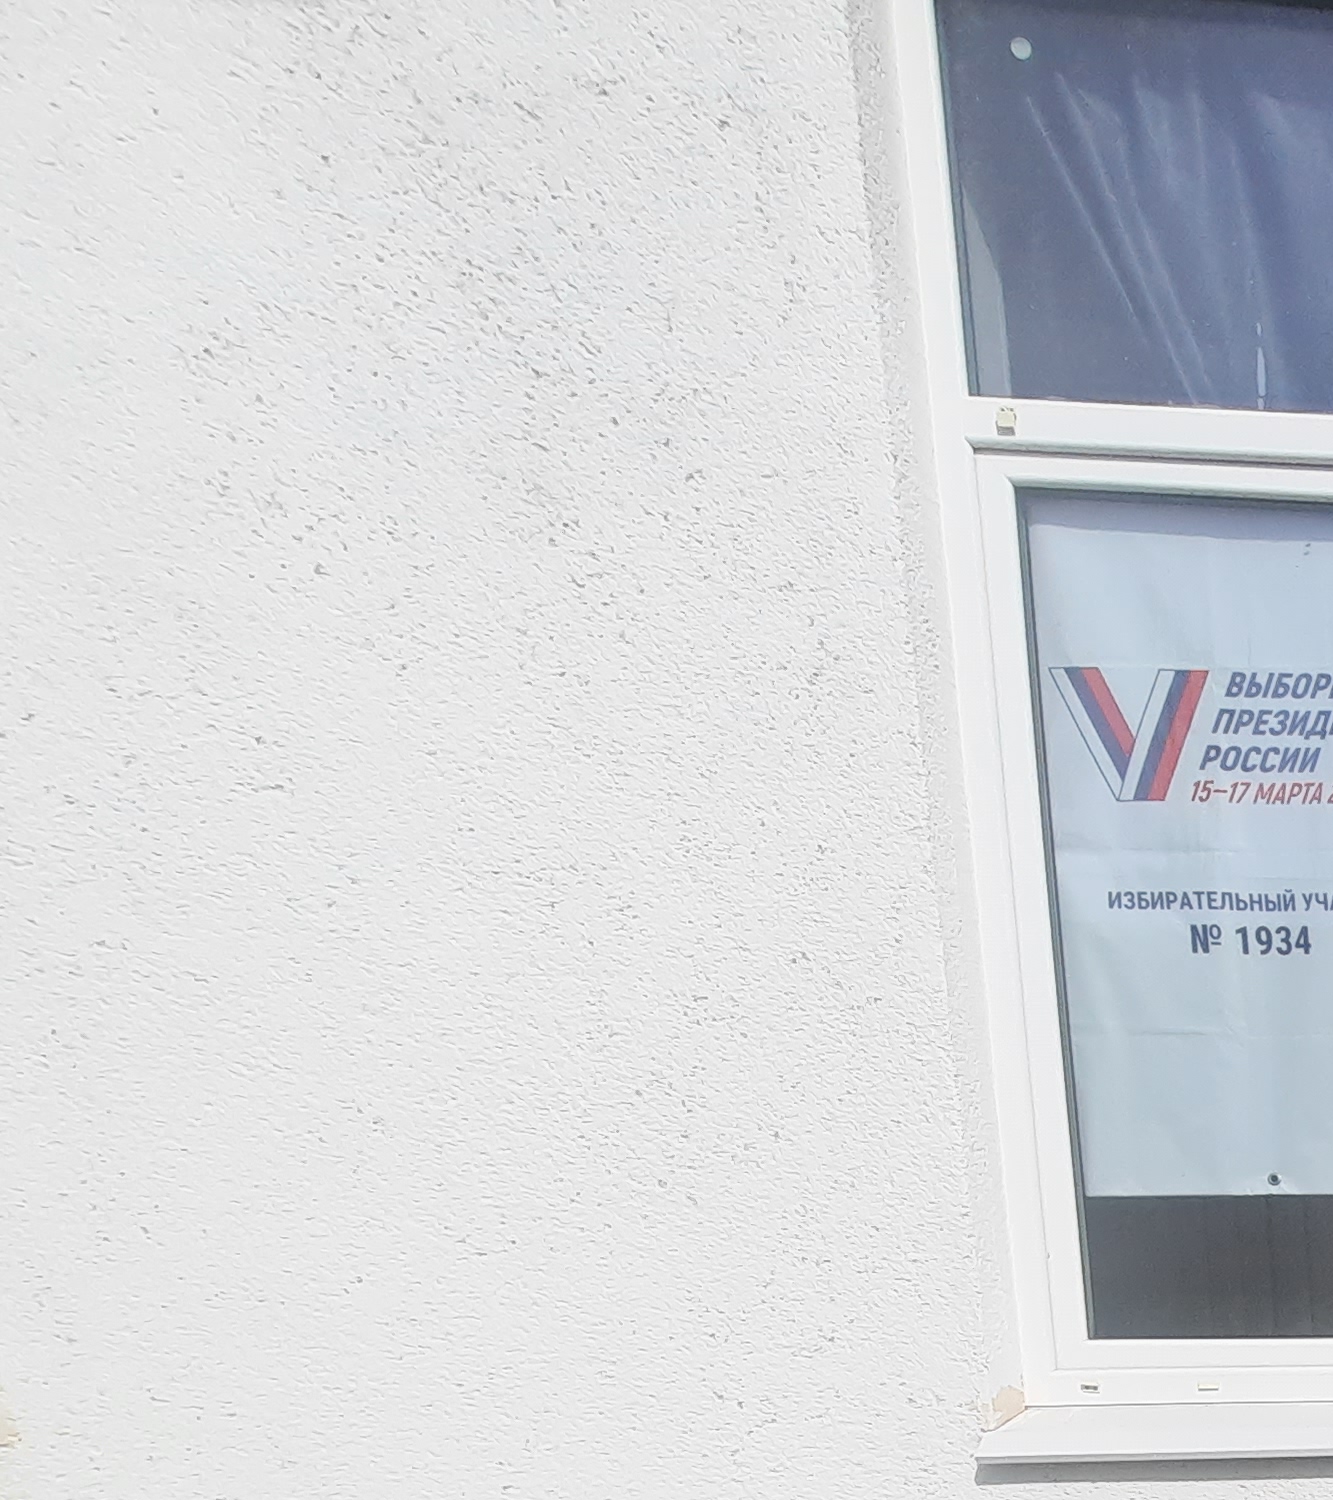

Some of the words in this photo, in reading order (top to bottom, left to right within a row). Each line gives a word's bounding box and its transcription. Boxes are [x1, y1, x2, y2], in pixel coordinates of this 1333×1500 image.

[1199, 746, 1323, 773] РОССИИ
[1253, 782, 1324, 806] МАРТА
[1107, 888, 1297, 914] ИЗБИРАТЕЛЬНЫЙ
[1190, 923, 1223, 955] №
[1235, 925, 1313, 956] 1934
